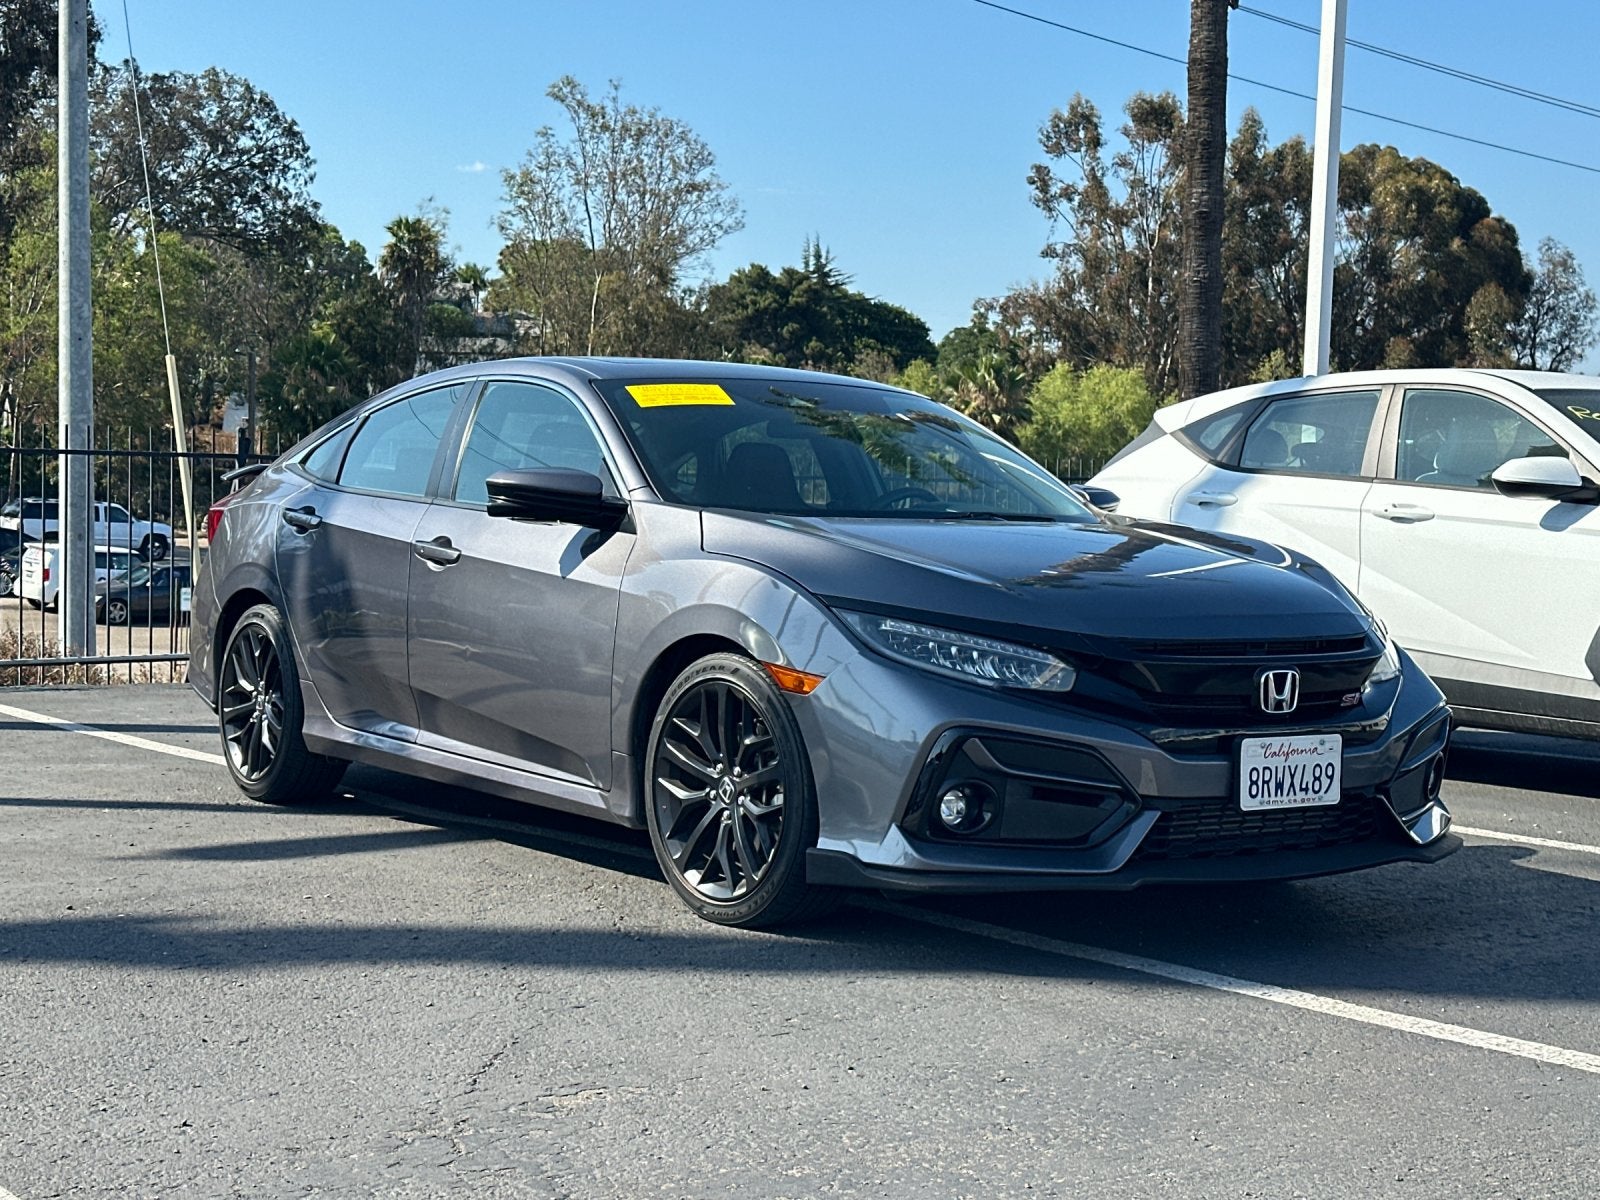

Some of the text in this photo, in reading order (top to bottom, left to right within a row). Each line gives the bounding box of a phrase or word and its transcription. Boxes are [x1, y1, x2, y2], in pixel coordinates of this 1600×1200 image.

[1263, 742, 1324, 762] California
[1248, 762, 1335, 799] 8RWX489
[1265, 797, 1317, 805] dmv.ca.gov
